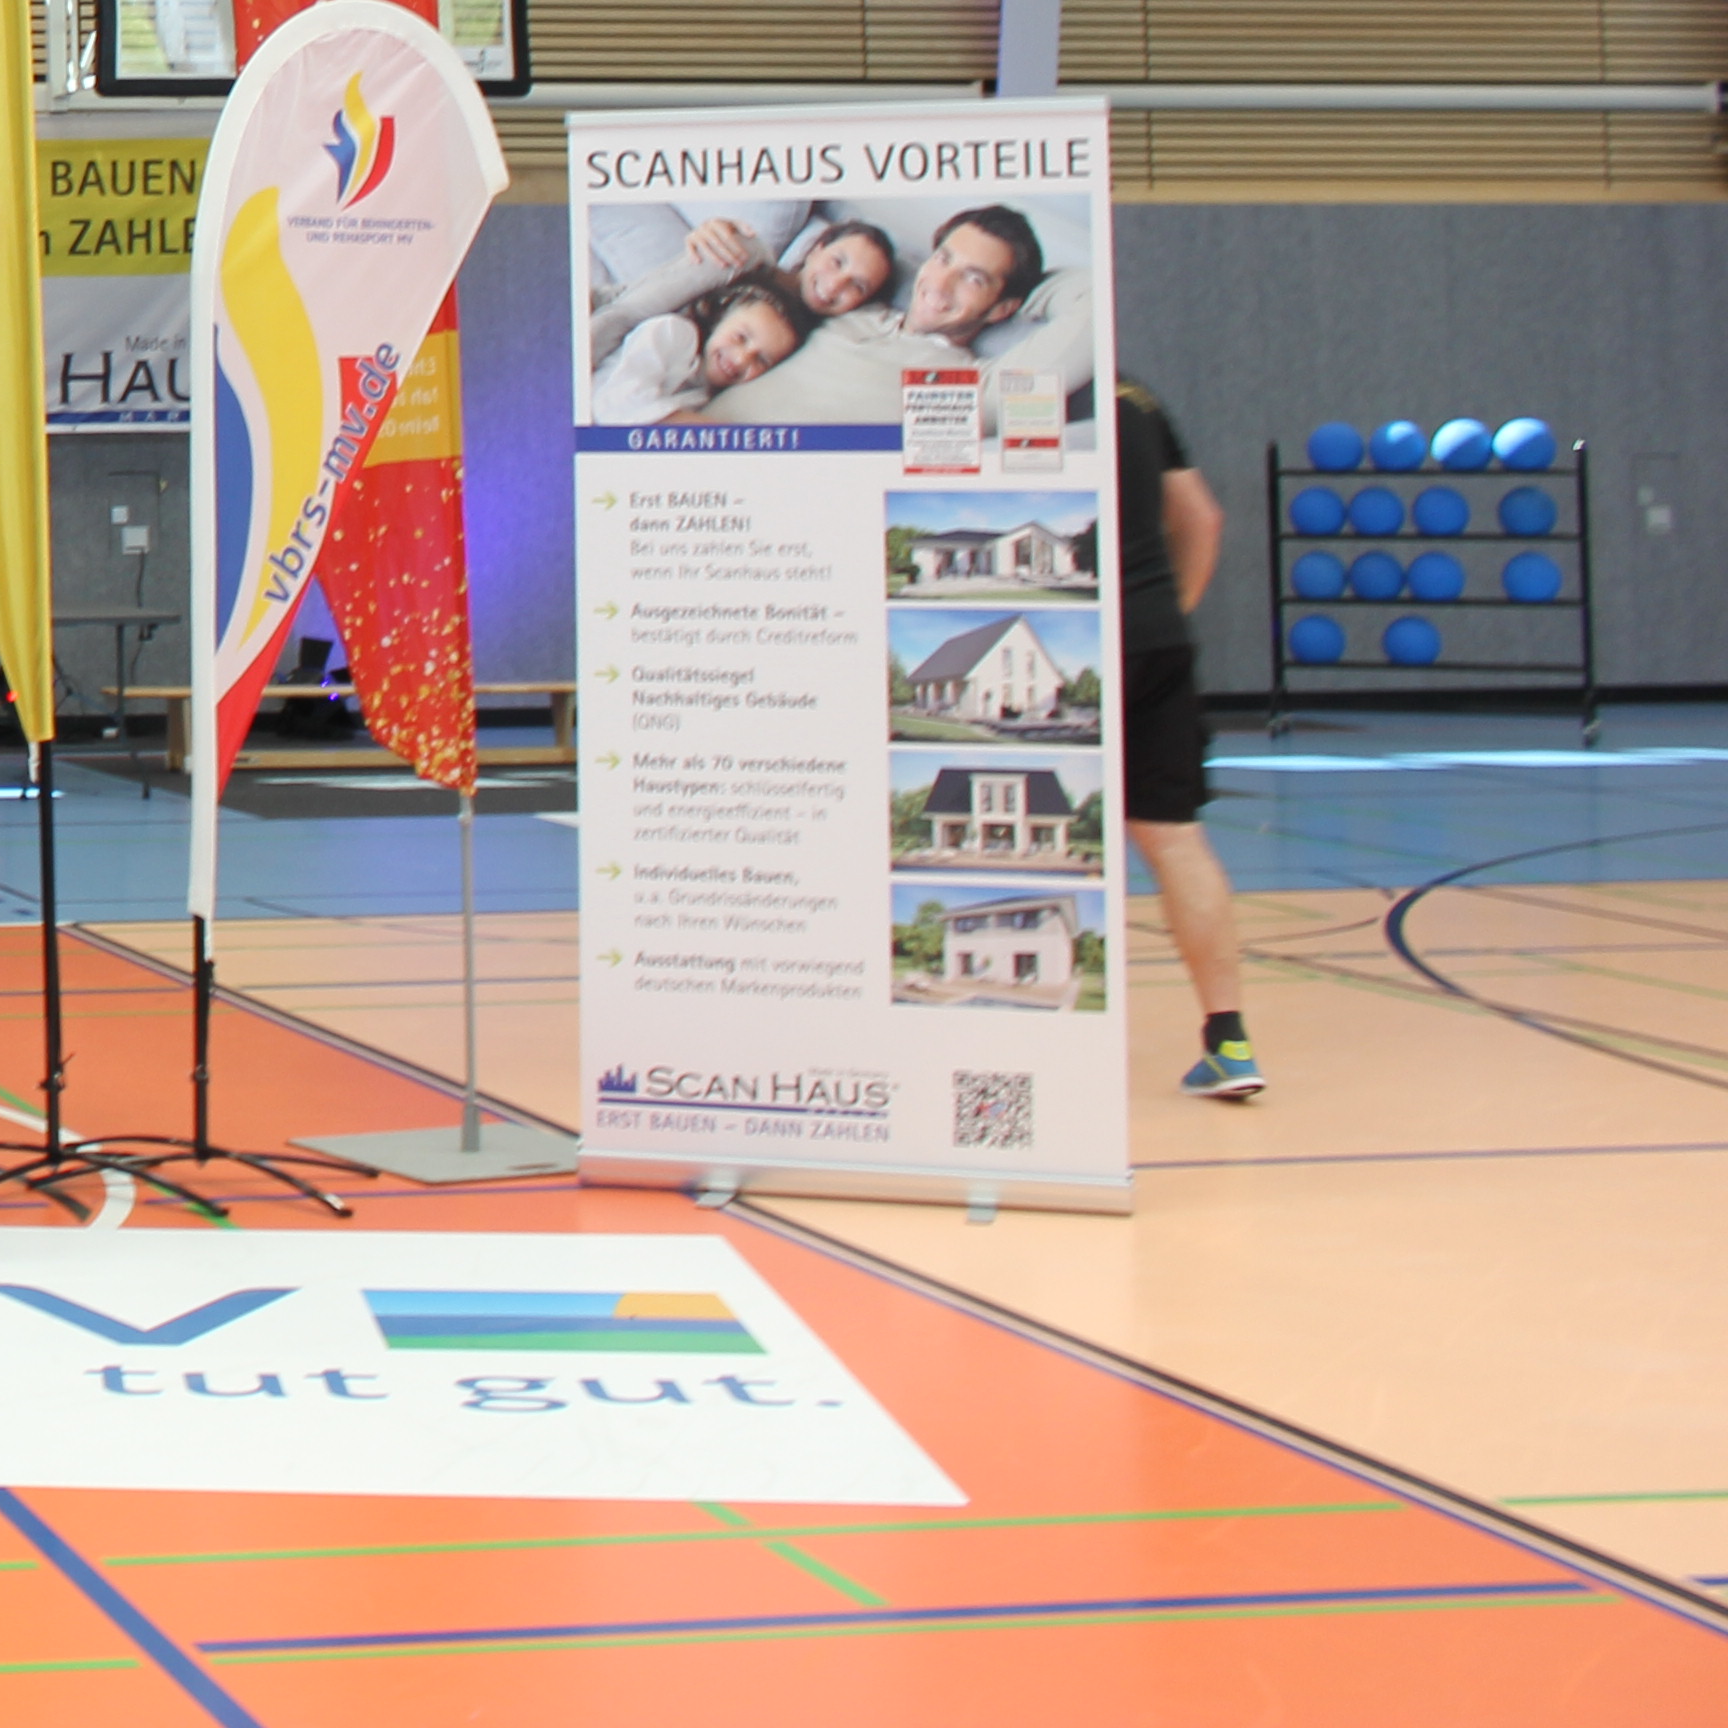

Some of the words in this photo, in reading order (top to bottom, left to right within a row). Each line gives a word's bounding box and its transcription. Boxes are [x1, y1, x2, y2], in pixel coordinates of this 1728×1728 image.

[51, 159, 196, 197] BAUEN
[587, 144, 844, 189] SCANHAUS
[865, 138, 1092, 183] VORTEILE
[68, 219, 193, 256] ZAHLE
[59, 351, 190, 404] HAU
[628, 428, 800, 450] GARANTIERT!
[264, 340, 401, 606] vbrs-mv.de
[630, 492, 661, 509] Erst
[668, 492, 727, 508] BAUEN
[630, 516, 670, 532] dann
[676, 516, 751, 532] ZAHLEN!
[630, 603, 757, 623] Ausgezeichnete
[632, 753, 675, 770] Mehr
[597, 1111, 640, 1129] ERST
[650, 1113, 716, 1134] BAUEN
[746, 1120, 802, 1139] DANN
[809, 1123, 889, 1143] ZAHLEN
[85, 1364, 393, 1400] tut
[455, 1368, 844, 1413] gut.
